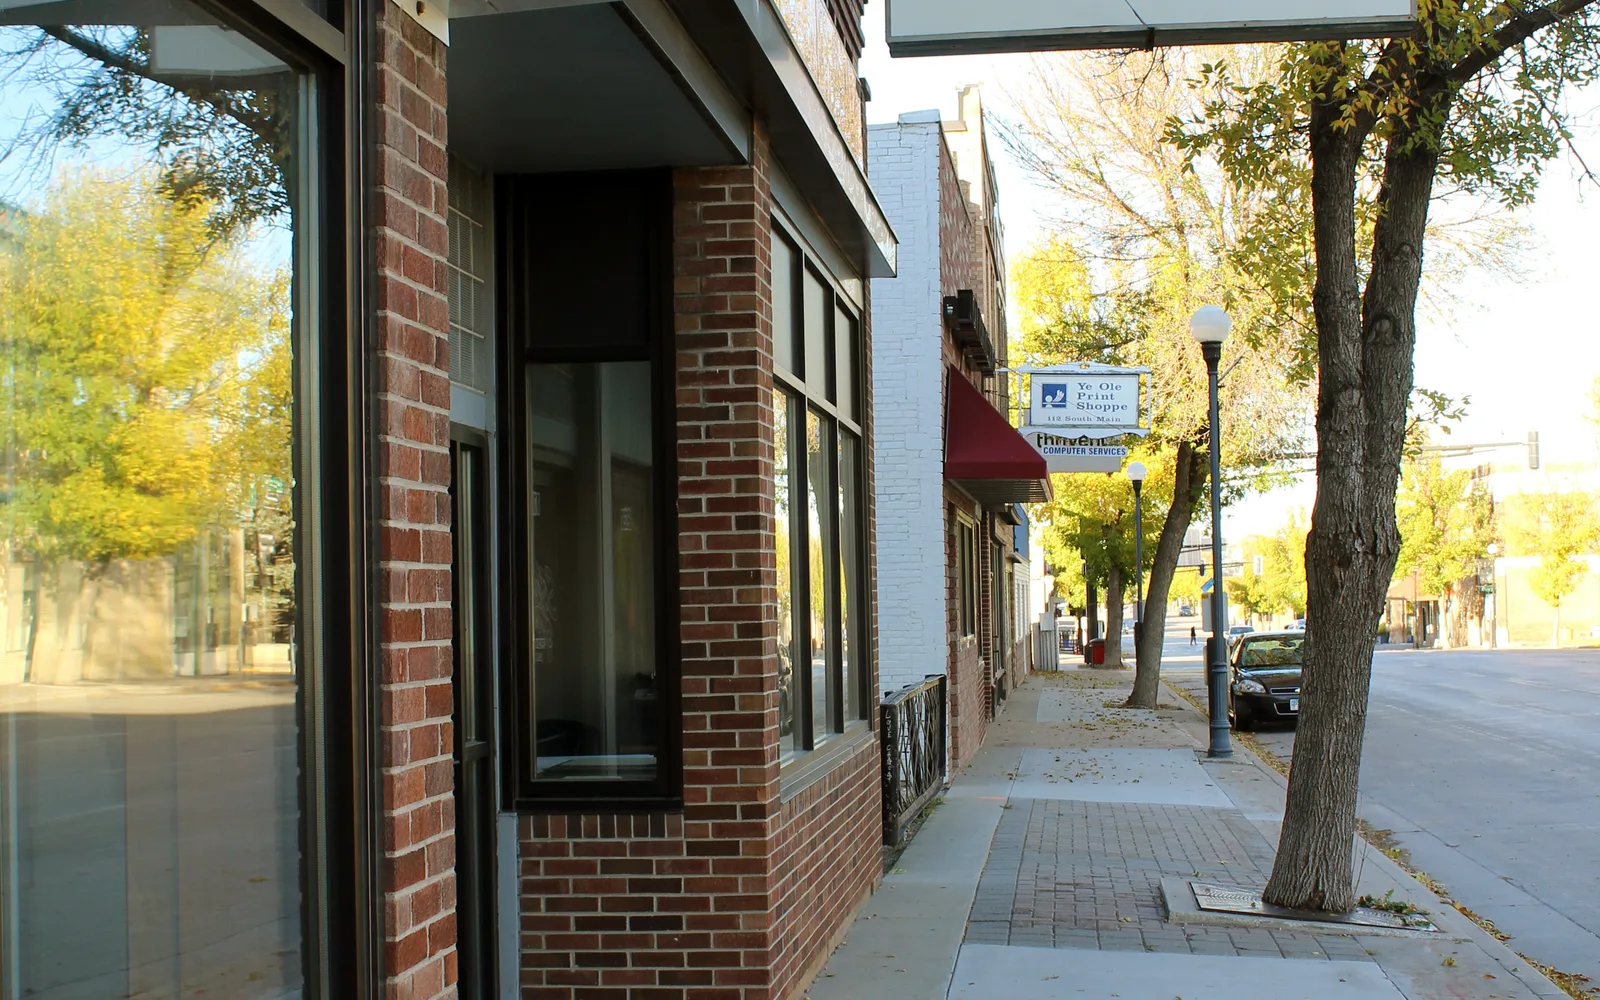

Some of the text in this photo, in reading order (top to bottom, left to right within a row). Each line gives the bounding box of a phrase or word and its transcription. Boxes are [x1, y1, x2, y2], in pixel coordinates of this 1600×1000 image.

[1077, 382, 1122, 391] Ye Ole
[1077, 392, 1115, 401] Print
[1076, 401, 1128, 412] Shoppe
[1043, 446, 1127, 457] COMPUTER SERVICES
